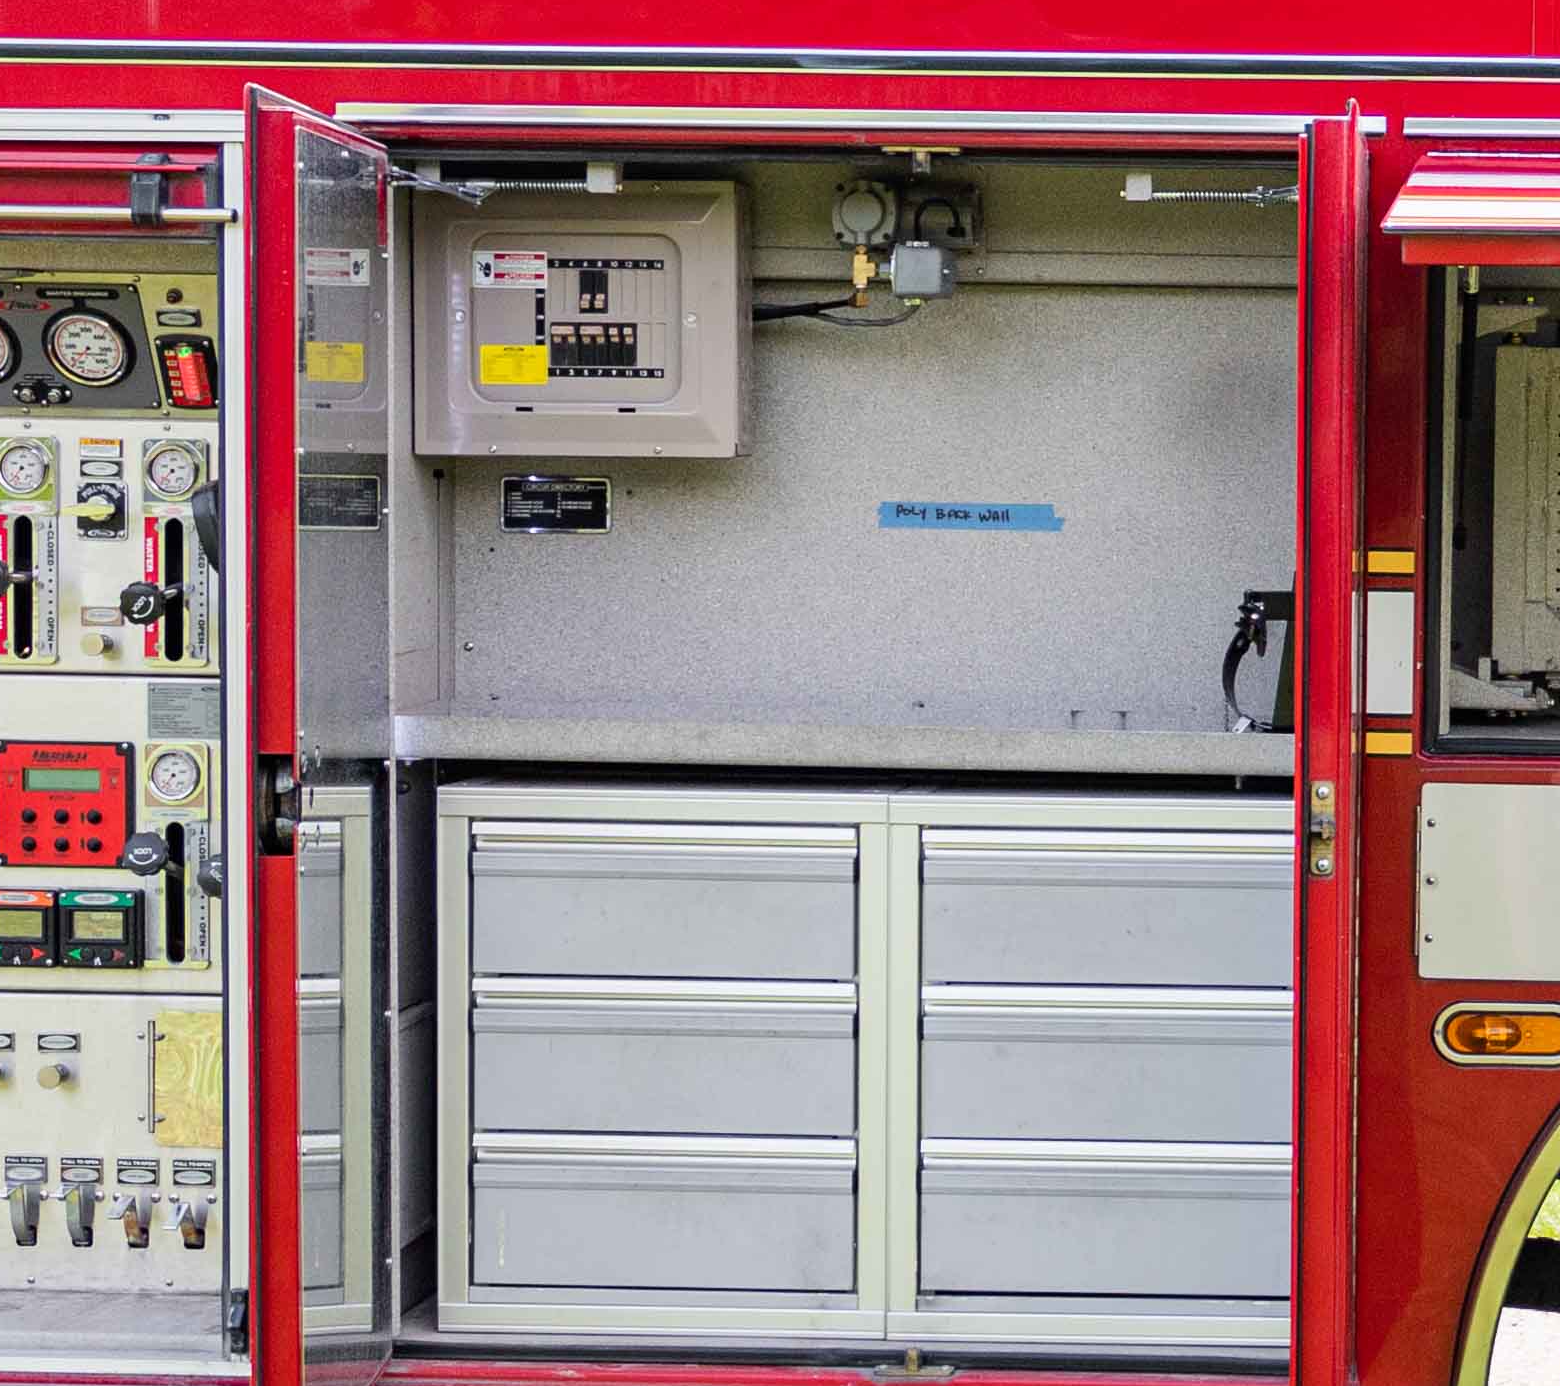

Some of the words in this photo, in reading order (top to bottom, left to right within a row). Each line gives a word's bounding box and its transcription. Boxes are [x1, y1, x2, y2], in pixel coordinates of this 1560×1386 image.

[936, 509, 972, 521] BACK
[47, 530, 55, 566] CLOSED
[146, 537, 154, 573] WATER
[132, 595, 148, 613] LOCK
[198, 620, 206, 645] OPEN
